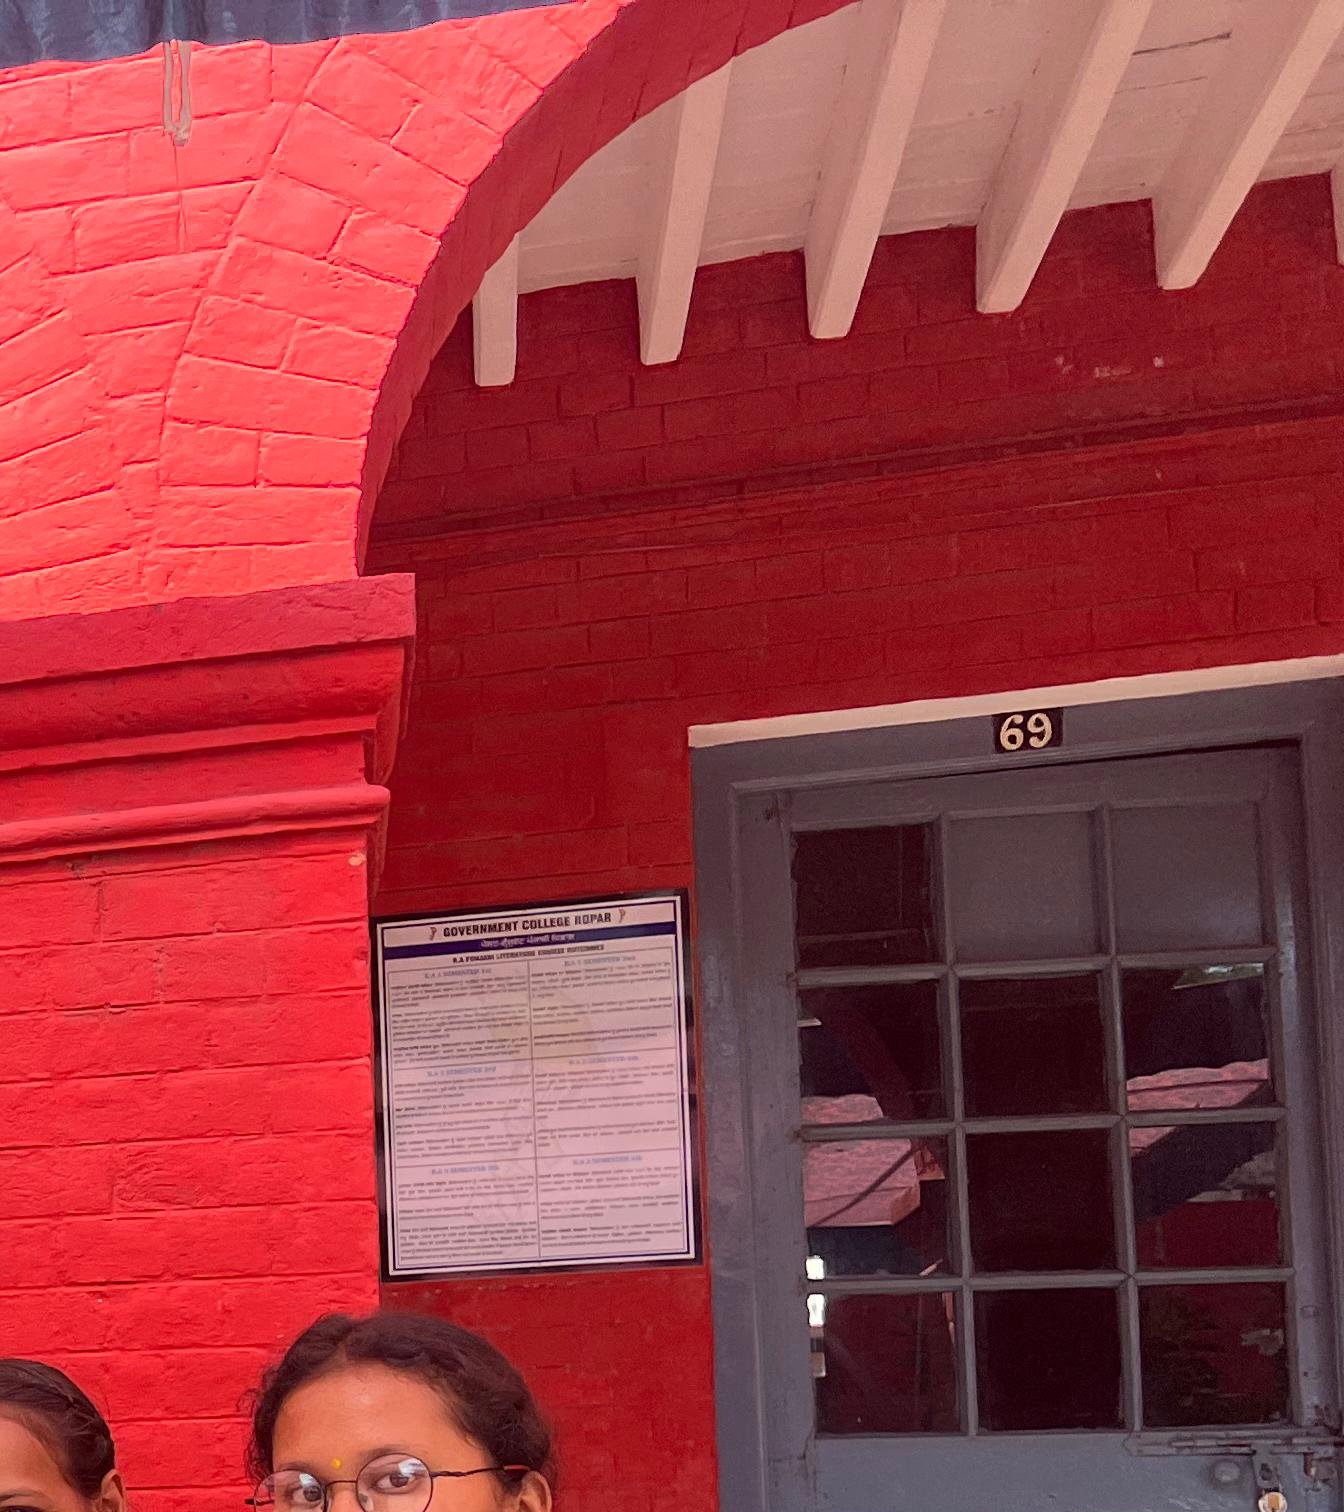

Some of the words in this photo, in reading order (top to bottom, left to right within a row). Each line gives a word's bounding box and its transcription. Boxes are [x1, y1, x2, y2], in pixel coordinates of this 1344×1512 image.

[1000, 712, 1053, 750] 69
[443, 920, 519, 937] GOVERNMENT
[521, 916, 571, 931] COLLEGE
[574, 912, 612, 926] ROPAR
